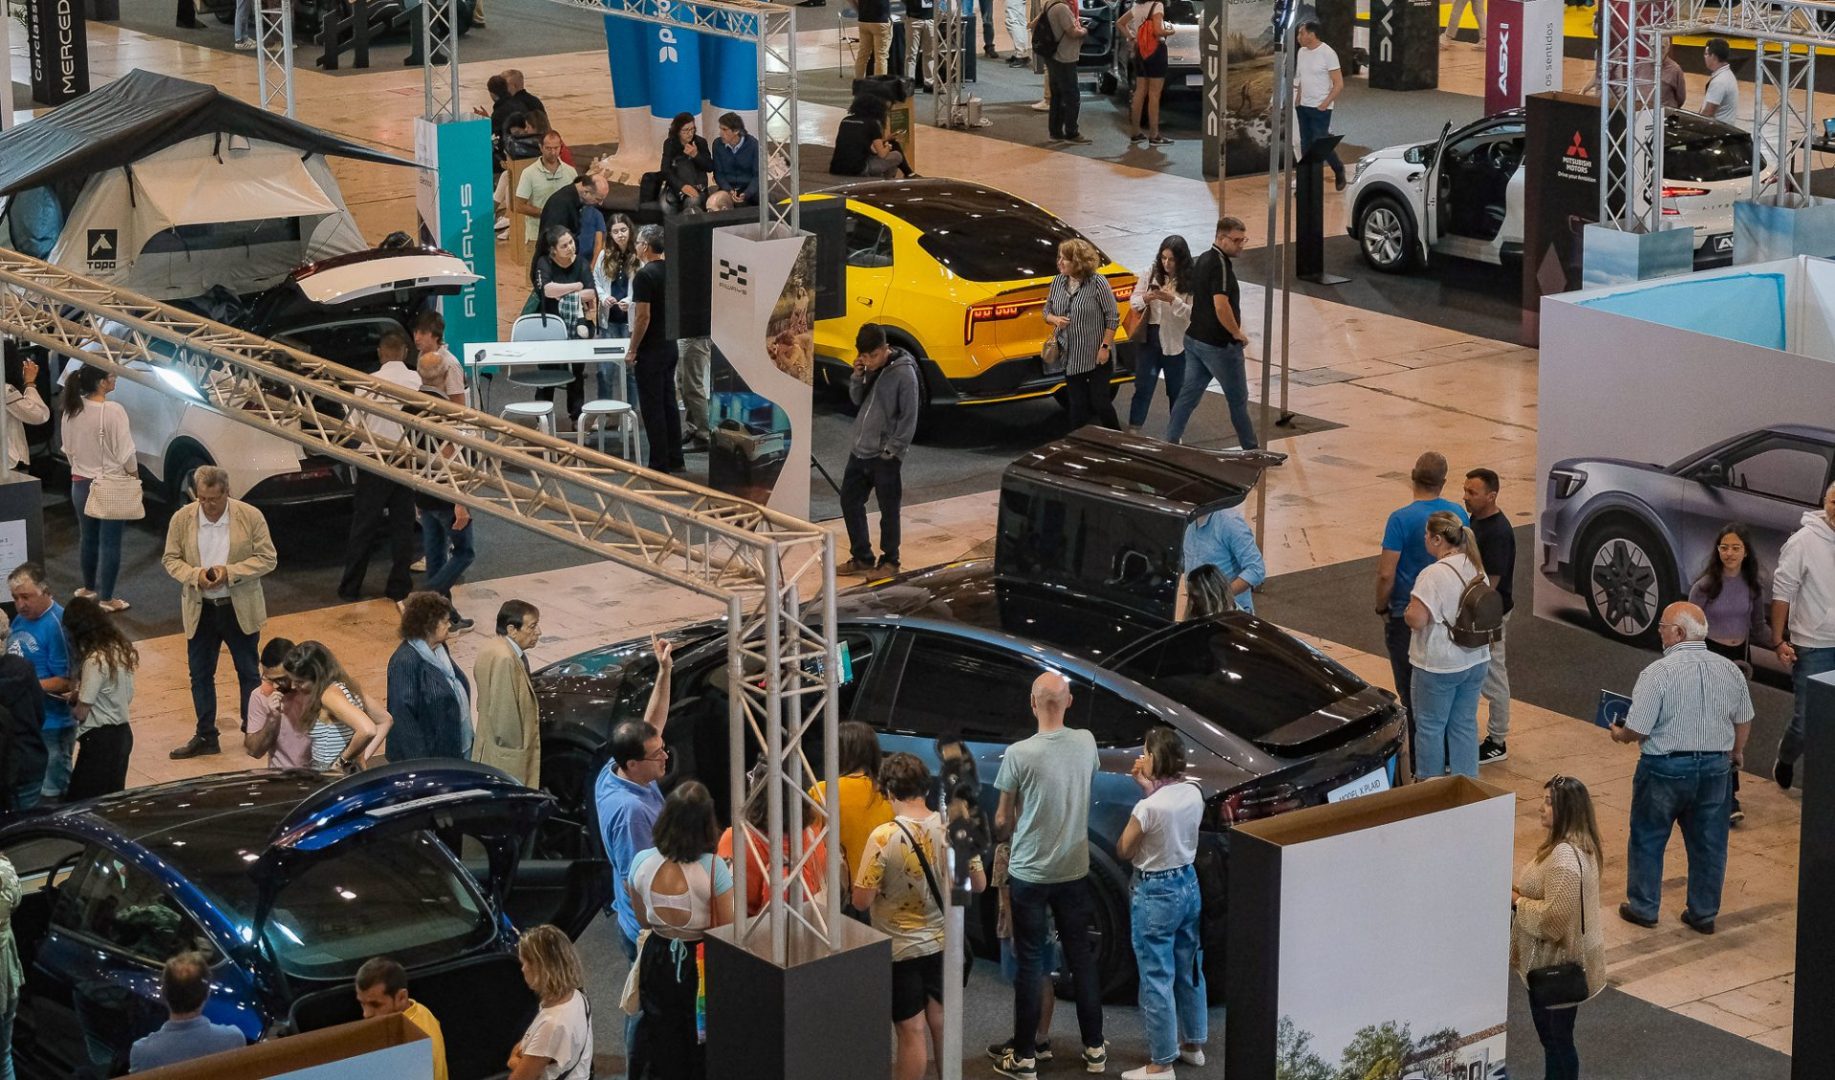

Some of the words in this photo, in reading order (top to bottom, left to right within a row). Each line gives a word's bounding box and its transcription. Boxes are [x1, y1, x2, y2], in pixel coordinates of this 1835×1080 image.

[1207, 15, 1218, 137] DACIA
[1562, 156, 1592, 168] MITSUBISHI
[1566, 164, 1588, 174] MOTORS
